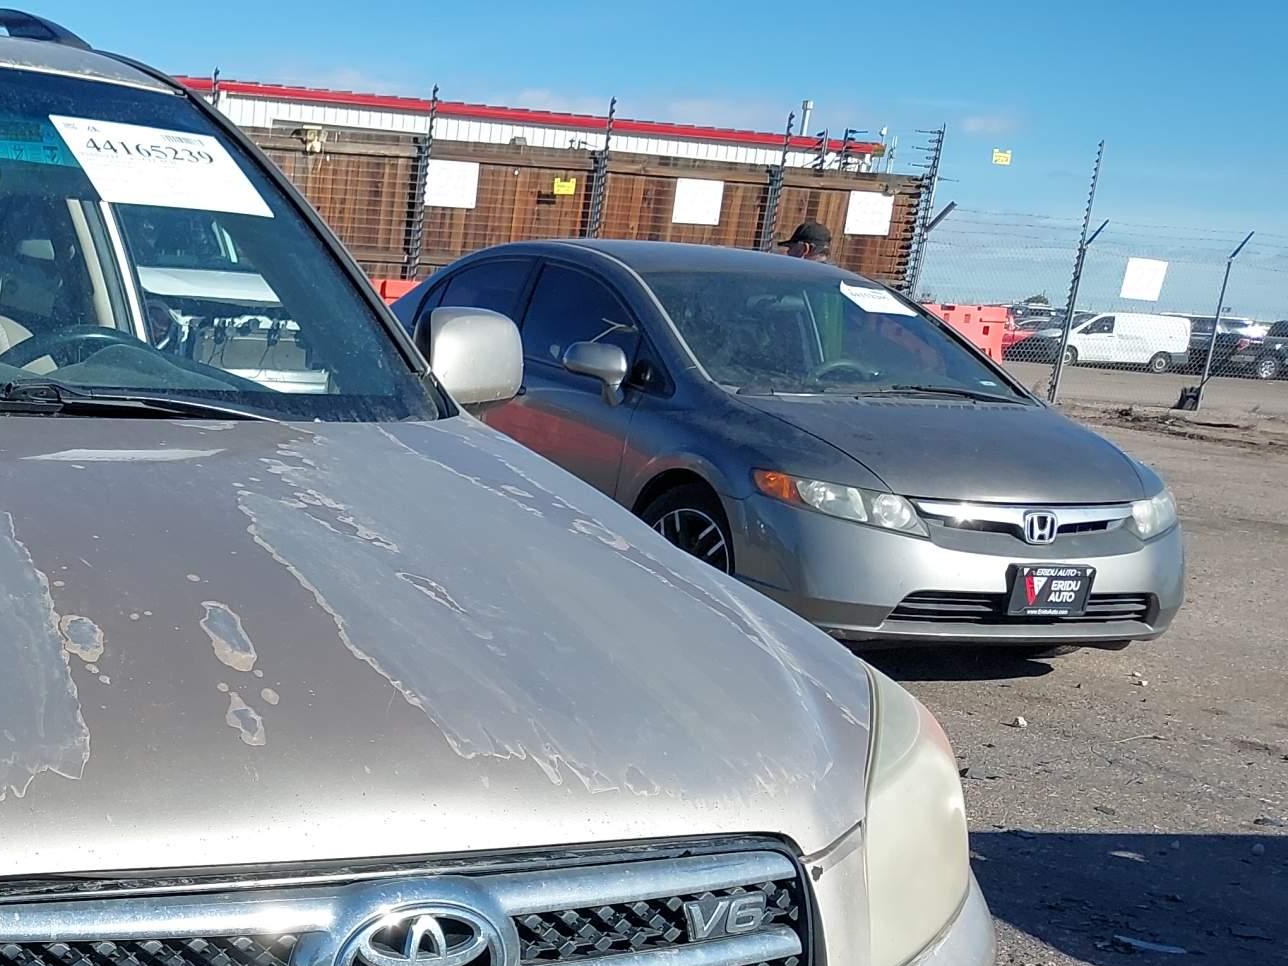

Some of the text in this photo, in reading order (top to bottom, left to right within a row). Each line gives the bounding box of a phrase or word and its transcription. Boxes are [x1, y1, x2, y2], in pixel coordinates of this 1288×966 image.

[86, 137, 214, 164] 44165239
[1037, 568, 1077, 577] ERIDU AUTO
[1051, 580, 1081, 591] ERIDU
[1047, 592, 1075, 603] AUTO
[688, 893, 766, 939] V6
